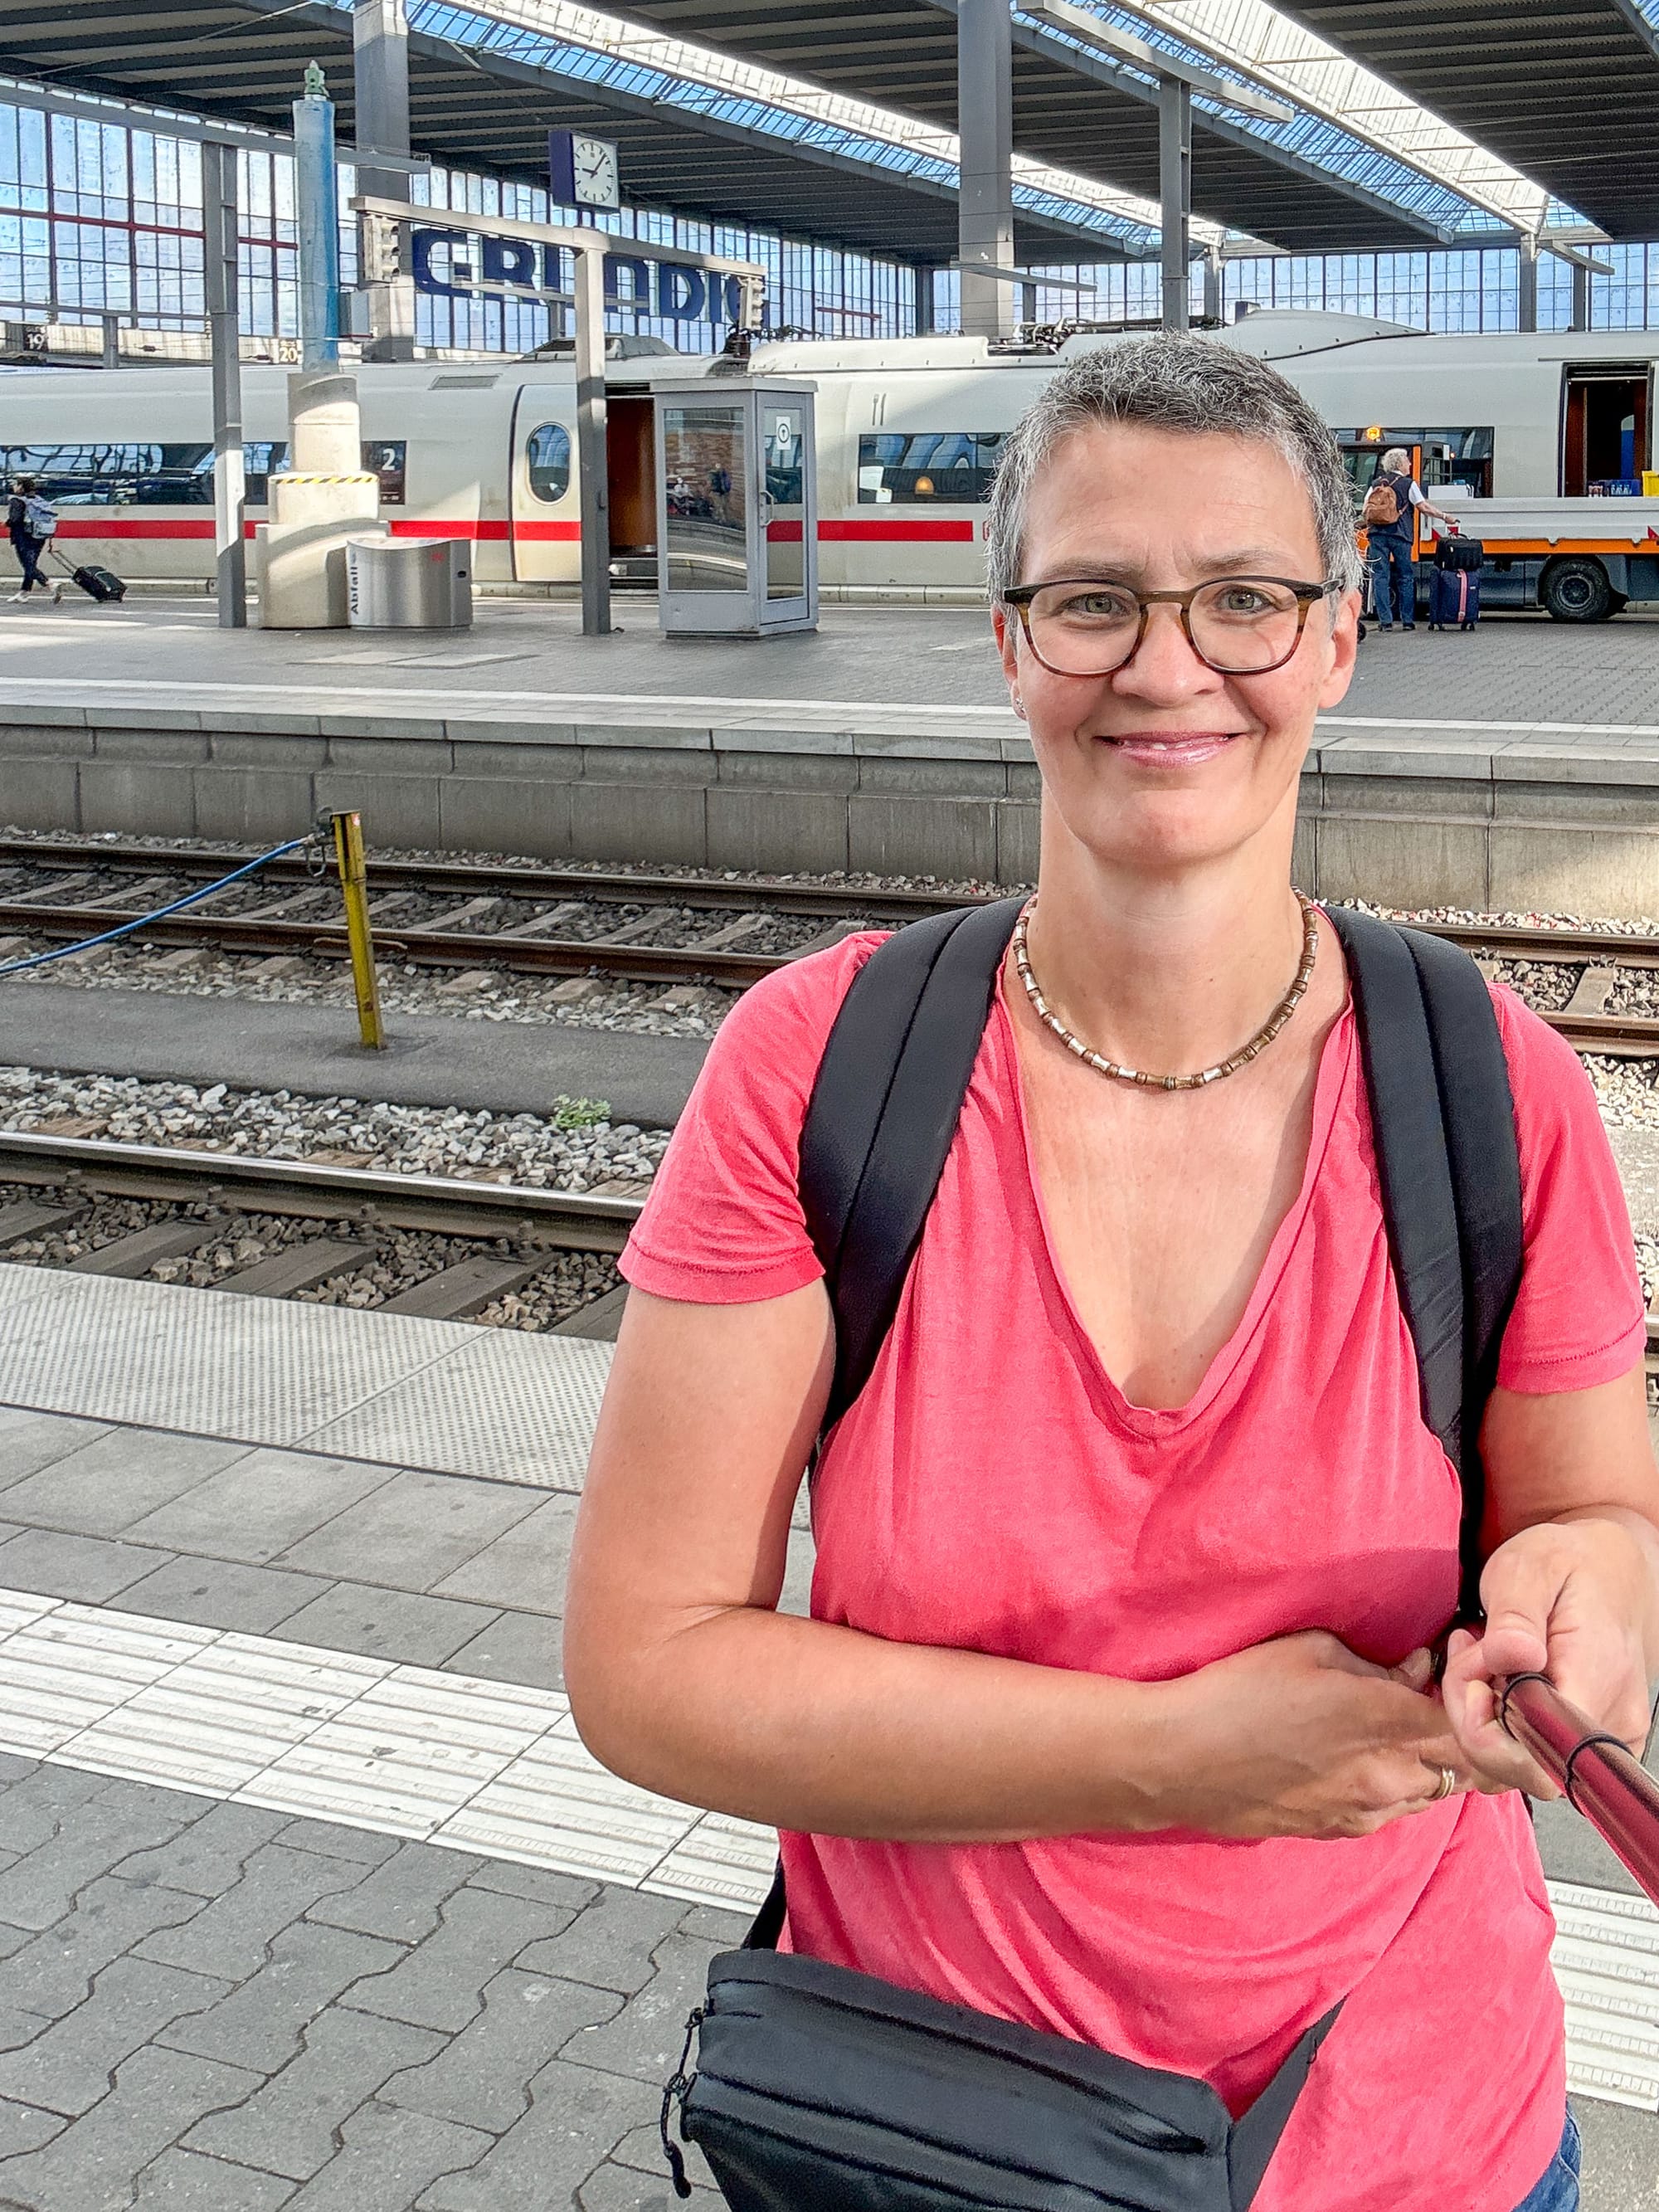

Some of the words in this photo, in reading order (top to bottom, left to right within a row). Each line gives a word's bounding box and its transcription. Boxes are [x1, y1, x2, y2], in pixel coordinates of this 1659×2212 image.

[27, 334, 45, 349] 19
[279, 347, 298, 362] 20
[382, 448, 396, 471] 2
[350, 567, 358, 615] Abfall
